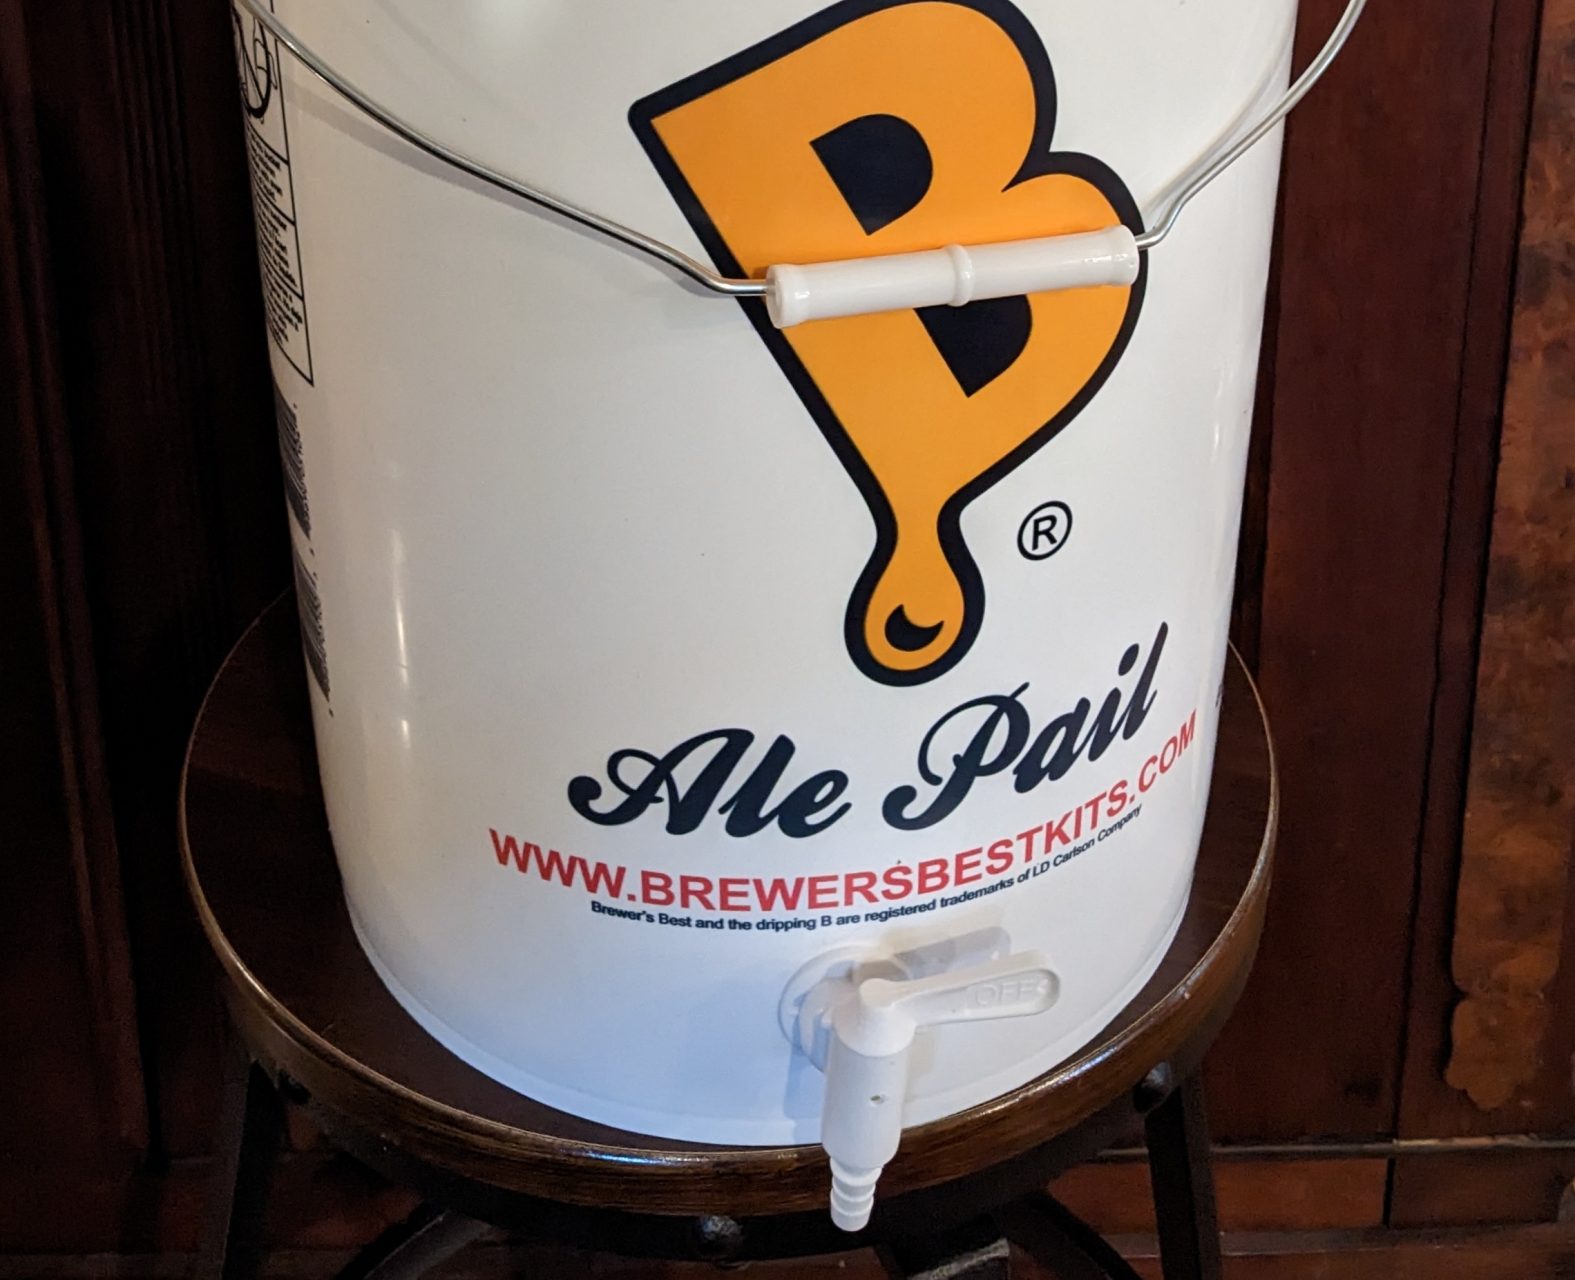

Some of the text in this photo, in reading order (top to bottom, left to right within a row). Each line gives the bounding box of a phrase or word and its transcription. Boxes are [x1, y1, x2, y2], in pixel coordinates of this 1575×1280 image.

[489, 708, 1197, 912] WWW.BREWERSBESTKITS.COM
[568, 621, 1169, 838] Ale Pail
[591, 803, 1143, 932] Brewer's Best and the dripping B are registered trademarks of LD Carlson Company
[975, 980, 1035, 1007] OFF
